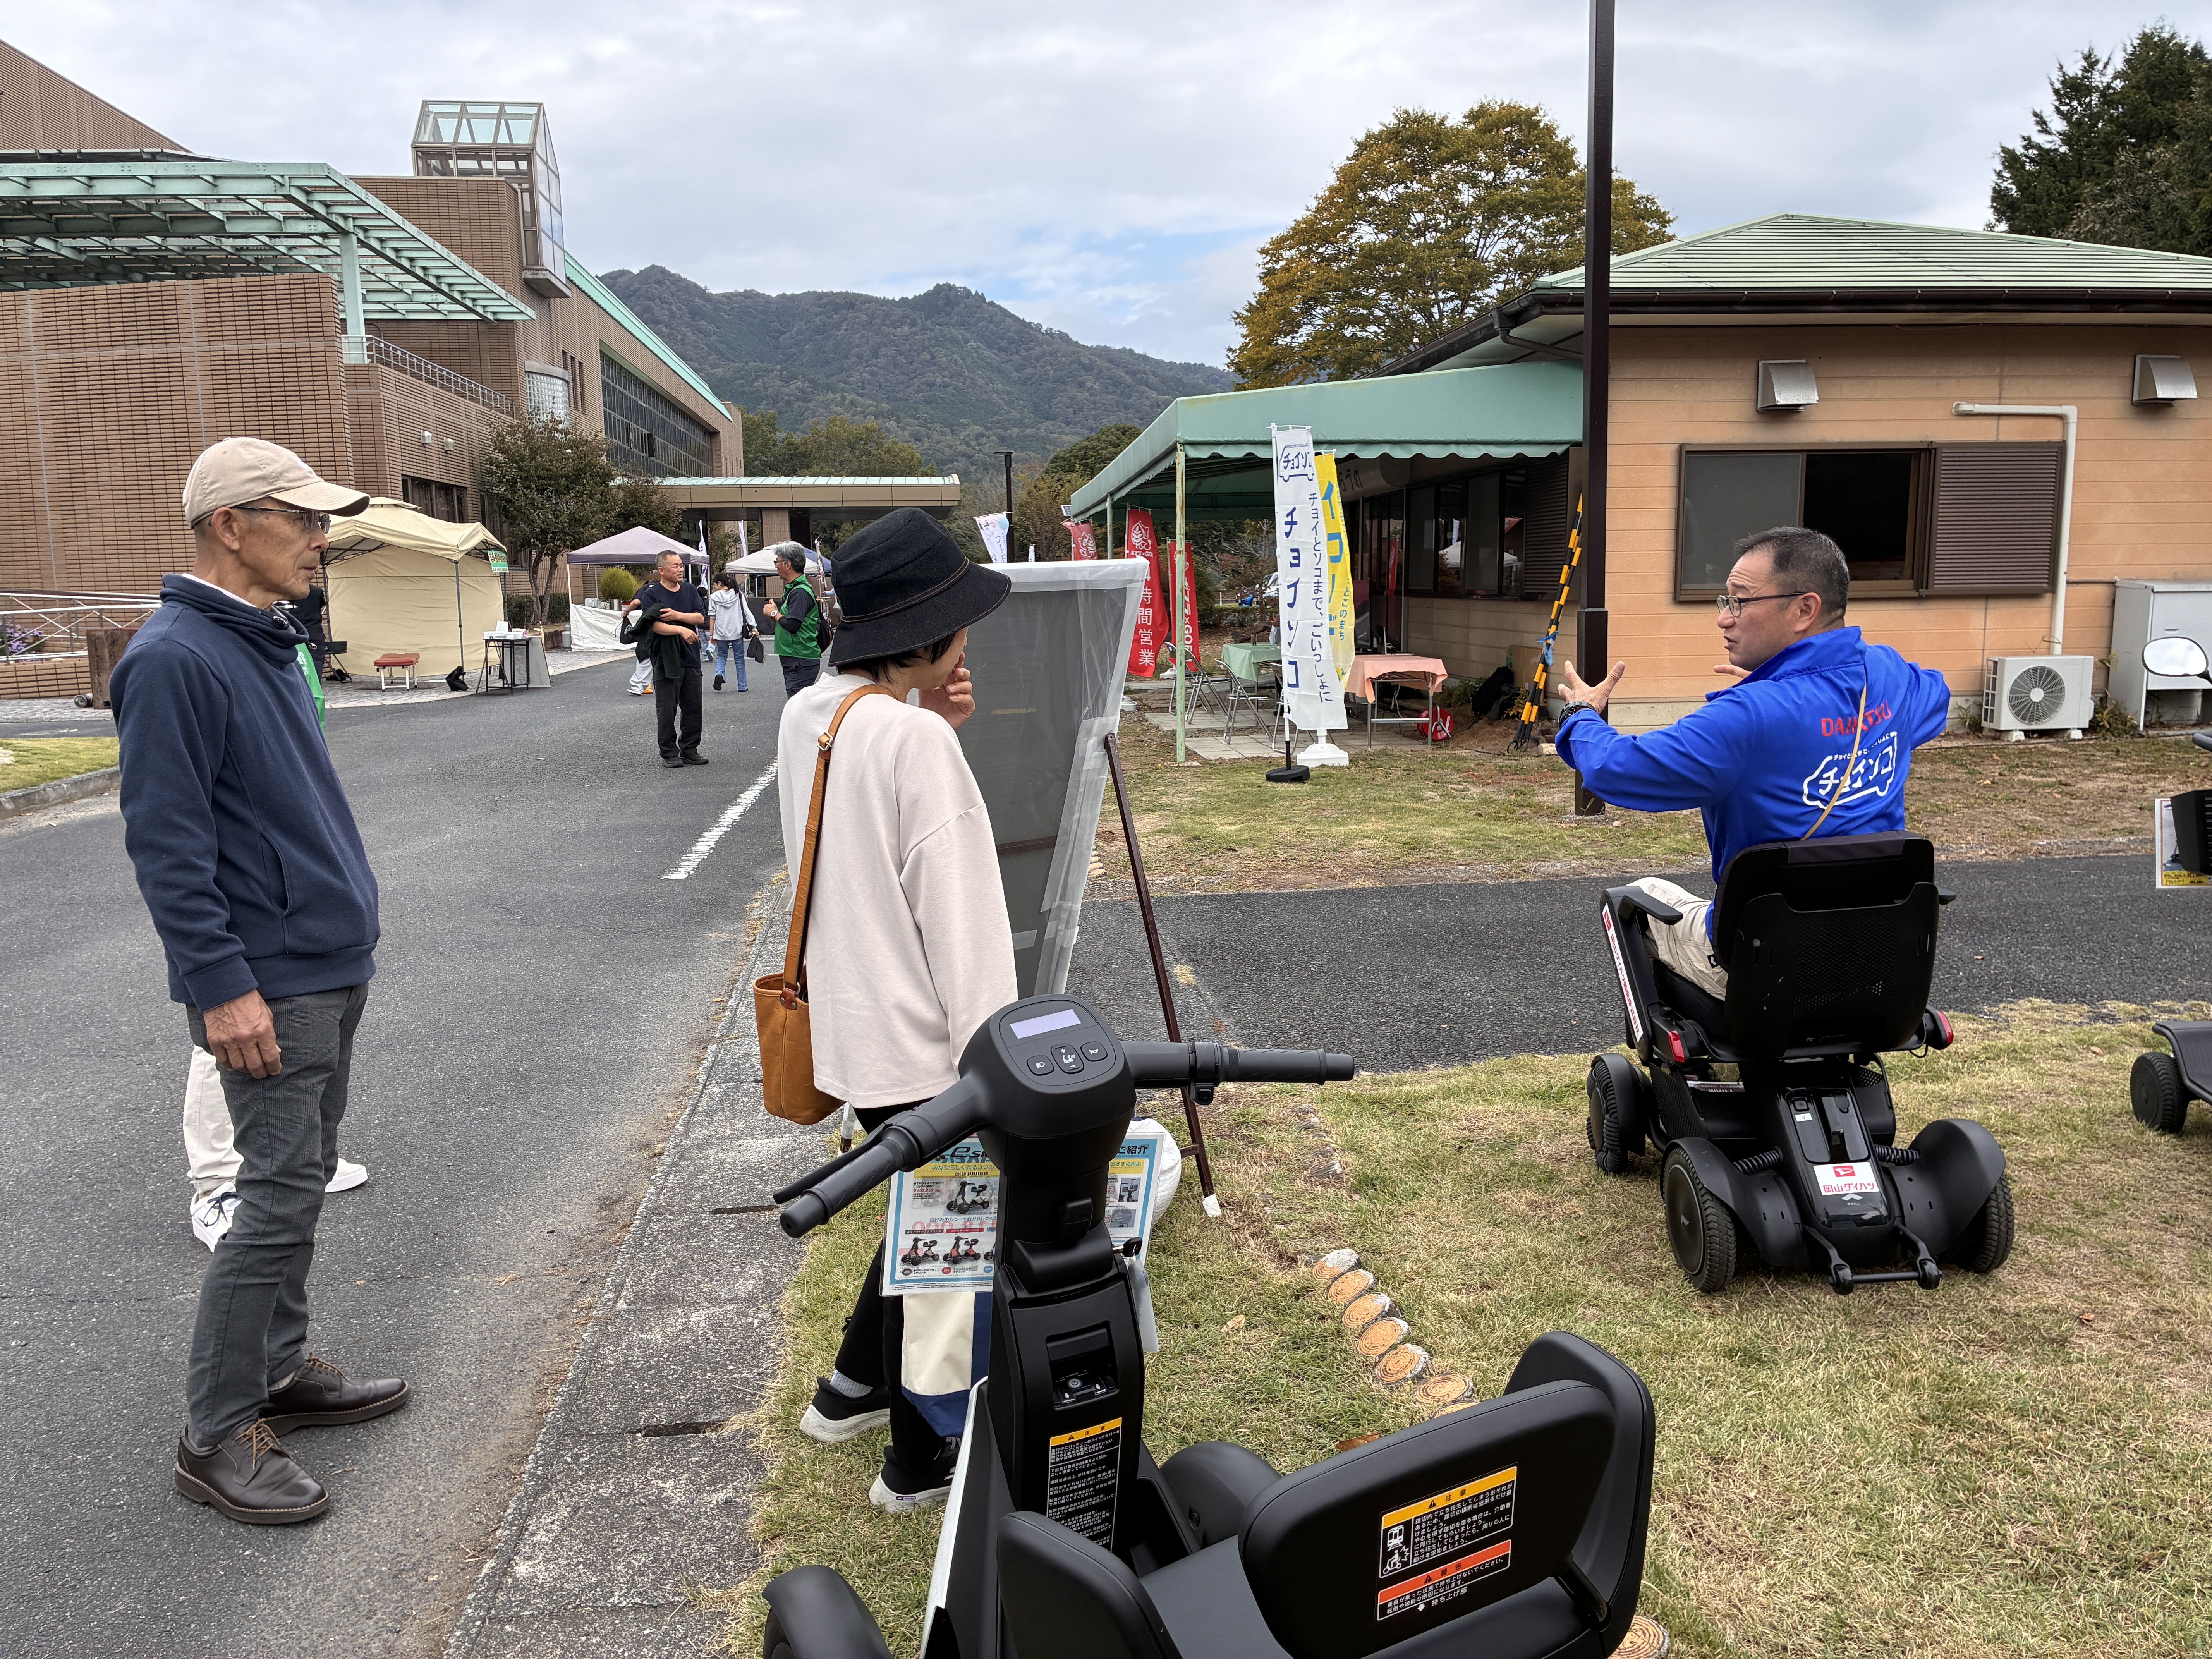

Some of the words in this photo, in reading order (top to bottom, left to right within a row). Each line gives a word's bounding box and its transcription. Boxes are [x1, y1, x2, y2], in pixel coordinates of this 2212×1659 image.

[1283, 452, 1312, 470] チョイソ
[1284, 506, 1302, 689] チョイソコ
[1309, 492, 1333, 703] チョイとソコまで、ごいっしょに
[1818, 745, 1893, 796] チョイソコ
[1118, 1145, 1148, 1154] ご紹介
[1823, 1182, 1875, 1193] 岡山ダイハツ
[1415, 1483, 1513, 1524] 踏切内で立ち往生してしまうおそれが
[1445, 1489, 1466, 1501] 注意
[1414, 1502, 1511, 1543] やむを得ず踏切を渡る場合は、介助者
[1414, 1519, 1486, 1550] に同行してもらいましょう。
[1414, 1515, 1510, 1557] 立ち往生してしまったら、周りの人に
[1415, 1522, 1446, 1537] けましょう。
[1413, 1539, 1468, 1563] 助けを求めましょう。
[1432, 1586, 1467, 1607] 持ち上げ部
